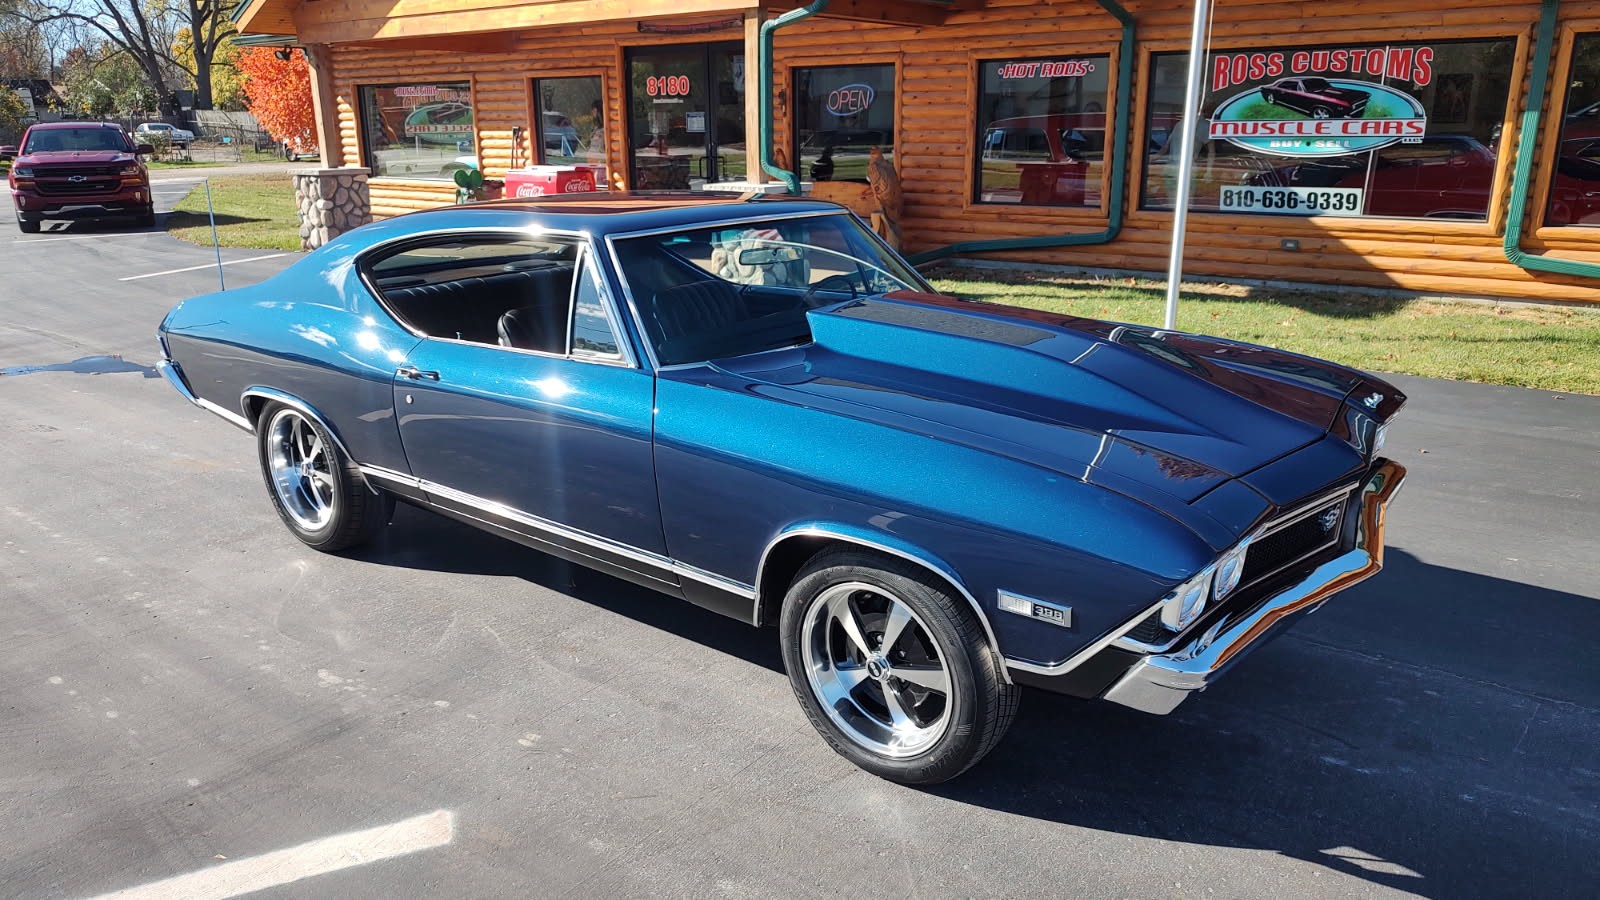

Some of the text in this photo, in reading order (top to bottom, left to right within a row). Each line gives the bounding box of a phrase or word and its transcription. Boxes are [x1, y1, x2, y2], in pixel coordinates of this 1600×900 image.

[1003, 61, 1090, 78] HOT RODS
[1212, 47, 1434, 92] ROSS CUSTOMS
[647, 75, 689, 95] 8180
[828, 90, 870, 110] OPEN
[1210, 121, 1424, 135] MUSCLE CARS
[1270, 140, 1351, 148] BUY SELL
[1223, 189, 1358, 211] 810-636-9339
